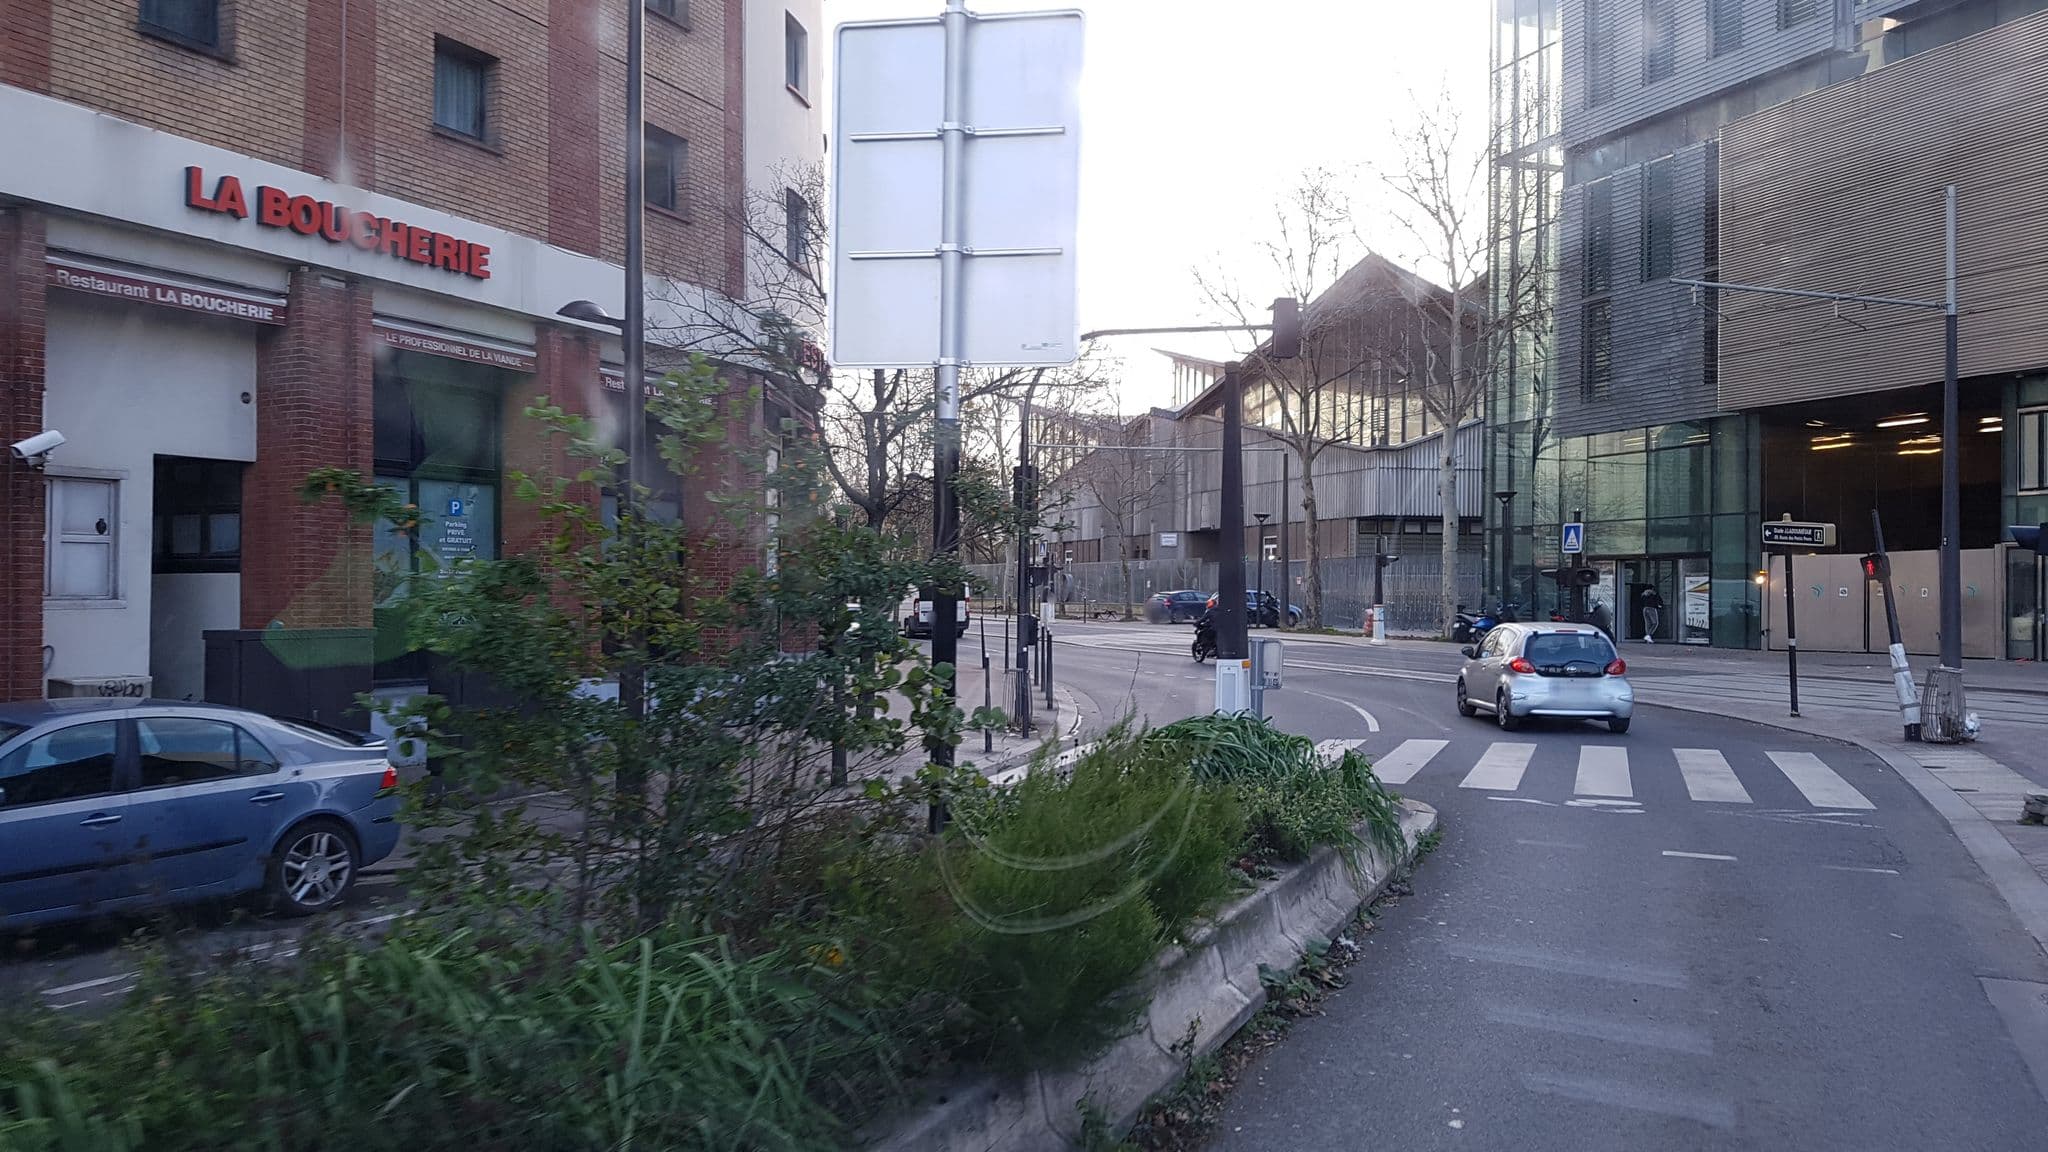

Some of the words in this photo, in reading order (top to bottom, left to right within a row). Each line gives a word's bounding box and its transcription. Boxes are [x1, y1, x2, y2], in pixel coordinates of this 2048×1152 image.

[184, 165, 248, 220] LA
[257, 185, 491, 280] BOUCHERIE
[56, 269, 150, 299] Restaurant
[155, 287, 179, 304] LA
[181, 292, 274, 321] BOUCHERIE
[385, 332, 398, 343] LE
[399, 335, 468, 357] PROFESSIONNEL
[469, 348, 481, 359] DE
[482, 350, 493, 361] LA
[494, 352, 522, 367] VIANDE
[445, 521, 467, 529] Parking
